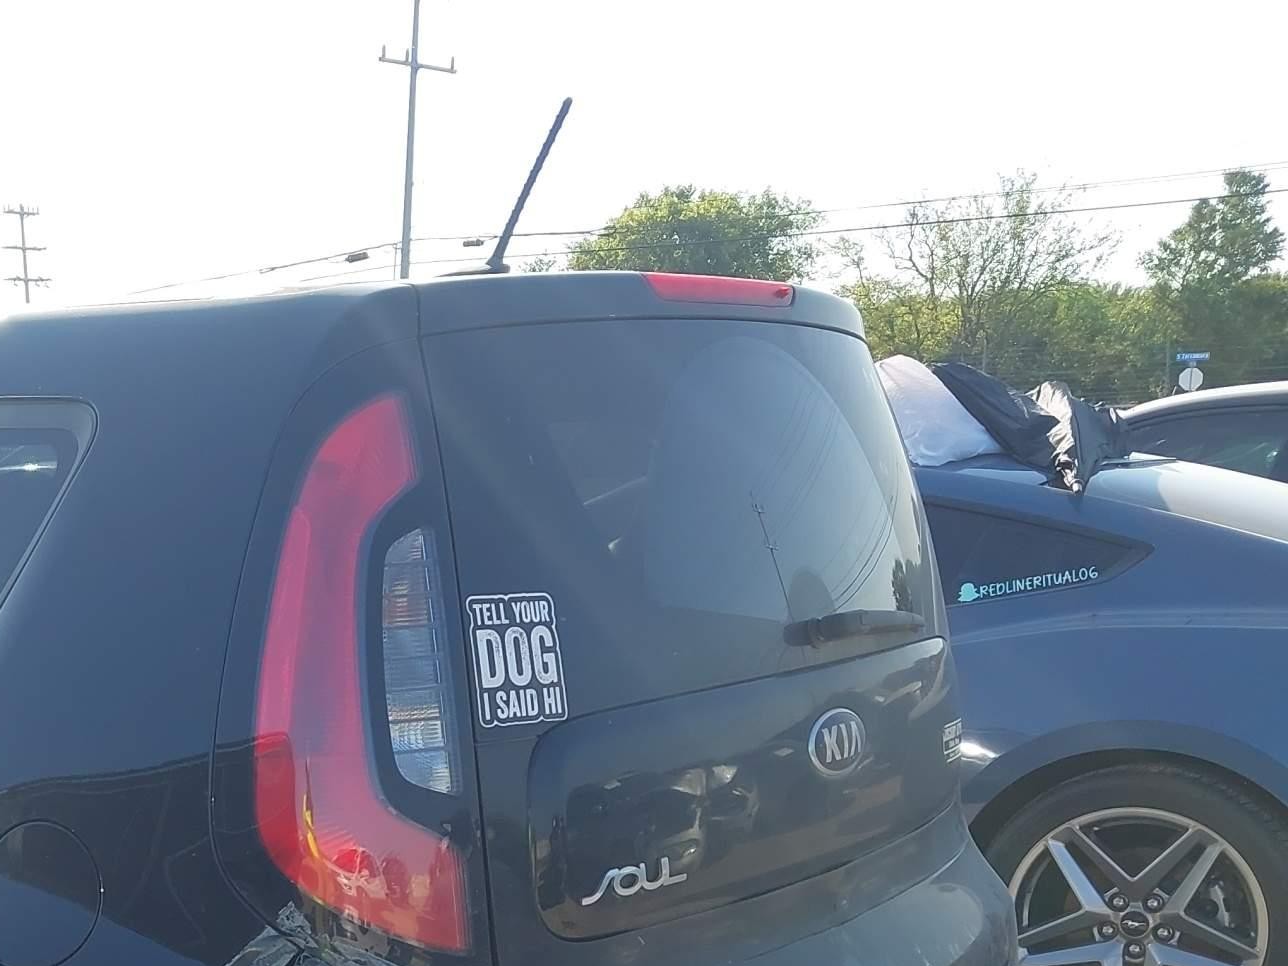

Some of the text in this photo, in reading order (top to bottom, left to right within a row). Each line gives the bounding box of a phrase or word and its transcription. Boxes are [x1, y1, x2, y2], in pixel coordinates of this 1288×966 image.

[472, 600, 550, 626] TELL YOUR
[475, 625, 559, 689] DOG
[483, 686, 563, 721] I SAID HI
